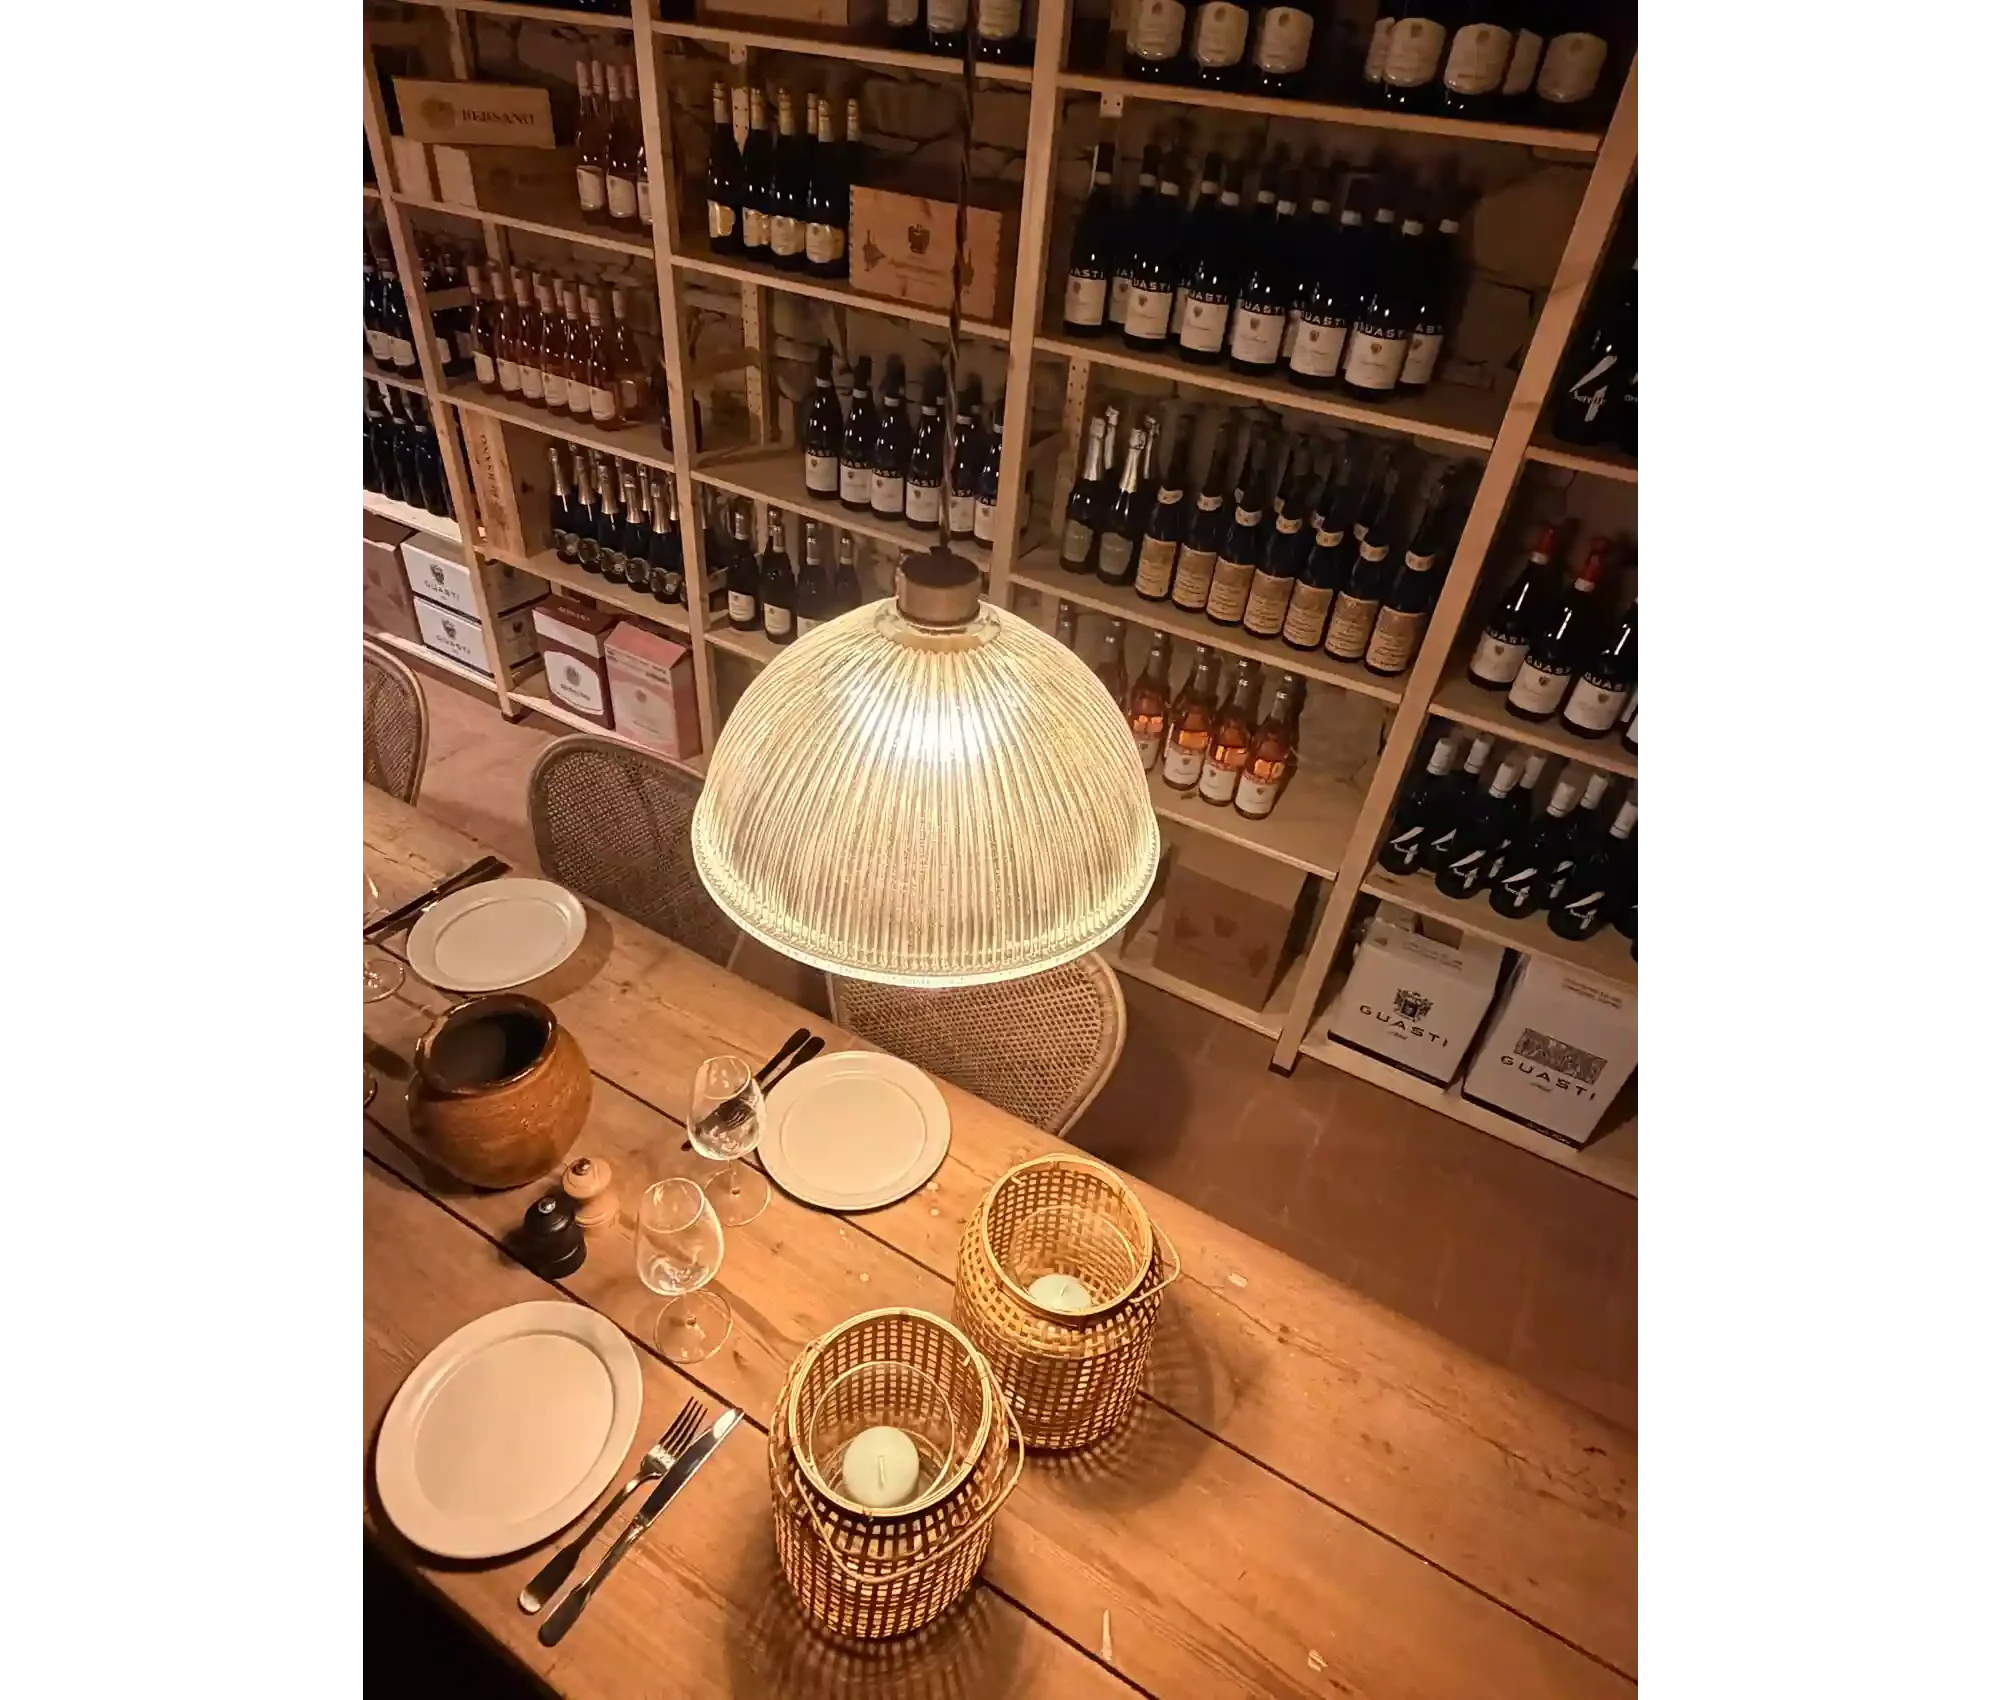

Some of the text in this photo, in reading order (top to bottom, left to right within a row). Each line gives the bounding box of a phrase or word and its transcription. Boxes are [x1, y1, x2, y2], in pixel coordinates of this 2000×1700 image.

[1132, 278, 1171, 293] UASTI
[1242, 299, 1285, 315] UASTI
[1359, 1004, 1448, 1048] GUASTI
[1500, 1055, 1597, 1101] GUASTI
